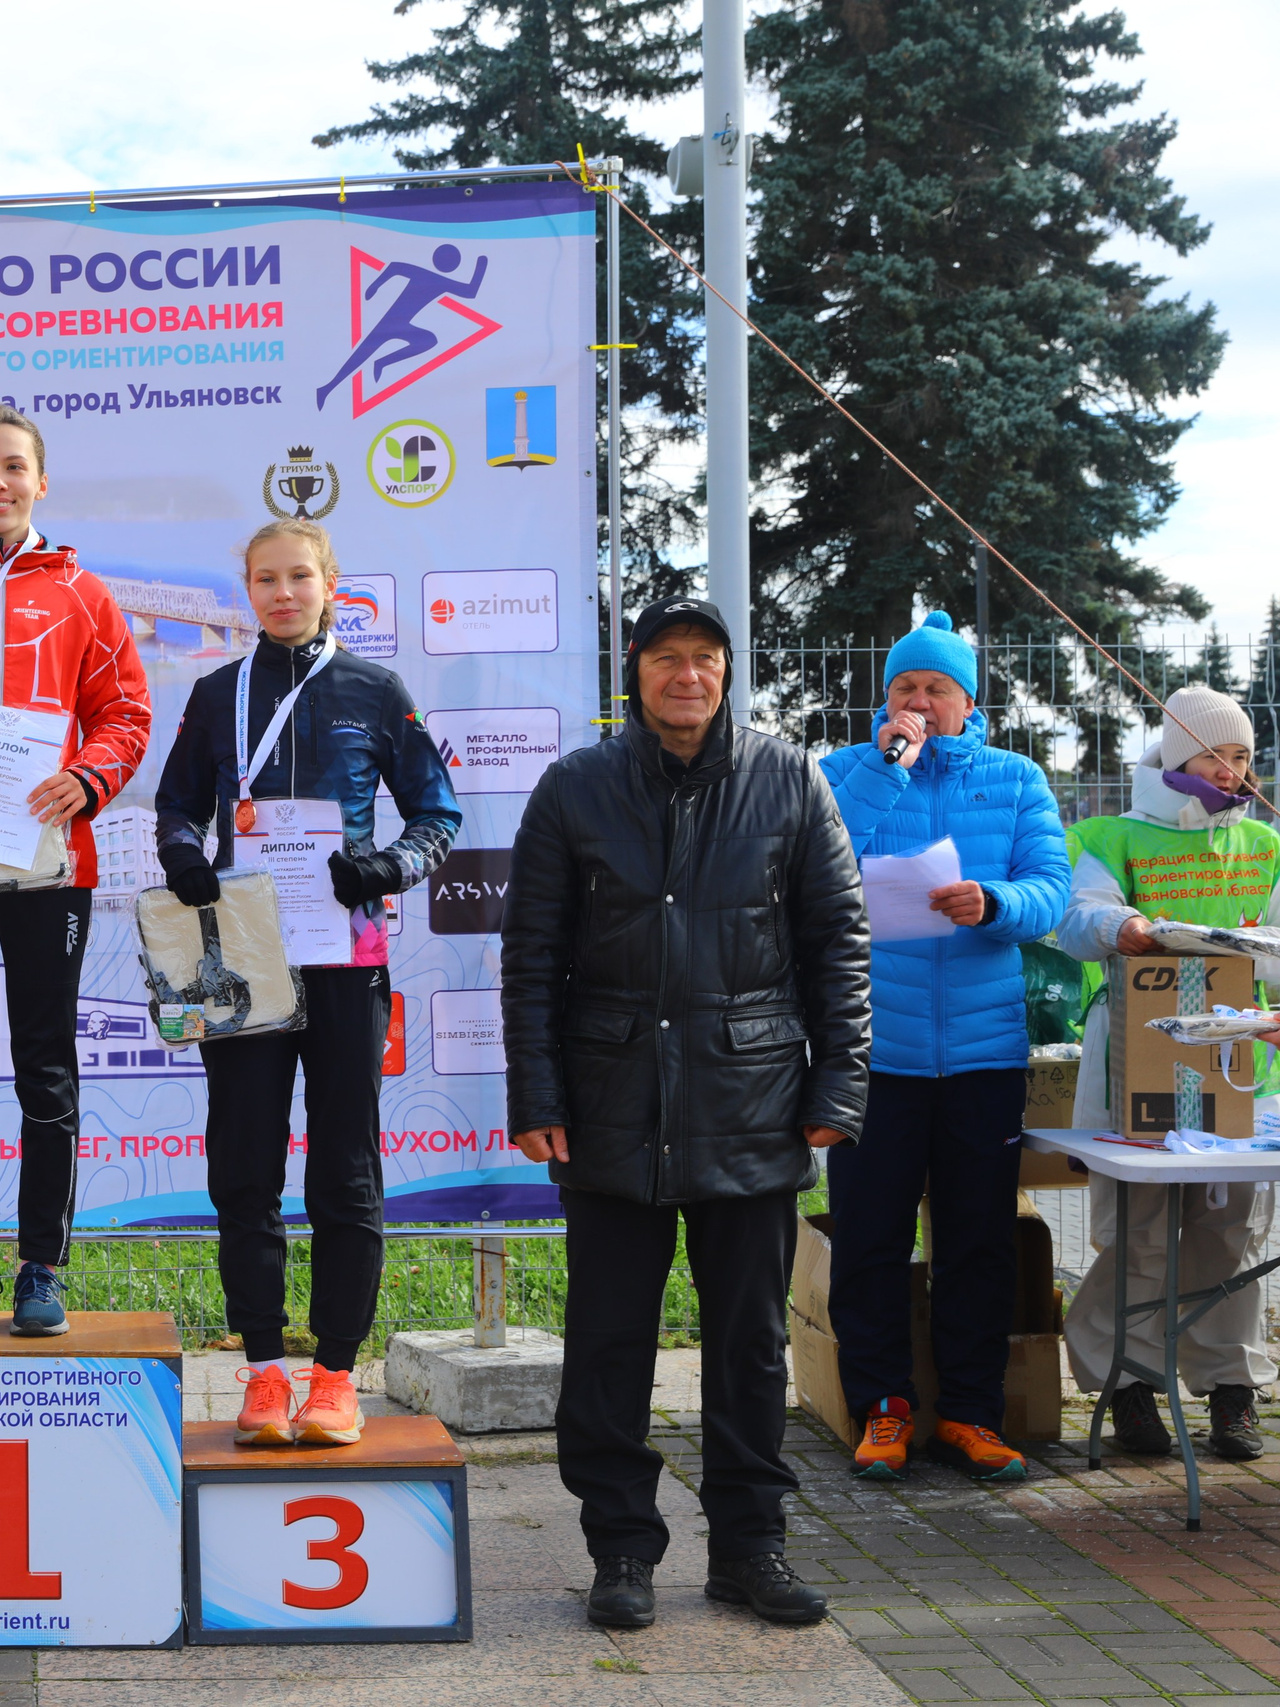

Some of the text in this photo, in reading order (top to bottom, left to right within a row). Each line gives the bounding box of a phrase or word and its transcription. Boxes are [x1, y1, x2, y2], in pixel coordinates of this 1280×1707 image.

[50, 245, 282, 294] РОССИИ
[32, 340, 285, 372] ОРИЕНТИРОВАНИЯ
[33, 392, 120, 419] город
[127, 383, 282, 410] Ульяновск
[279, 464, 322, 474] ТРИУМФ
[385, 484, 437, 495] УЛСПОРТ
[462, 594, 551, 616] azimut
[462, 622, 491, 630] ОТЕЛЬ
[467, 734, 527, 743] МЕТАЛЛО
[467, 743, 557, 755] ПРОФИЛЬНЫЙ
[467, 758, 509, 767] ЗАВОД
[261, 842, 315, 854] ДИПЛОМ
[1141, 1102, 1155, 1123] L
[76, 1136, 111, 1162] ЕГ,
[1, 1370, 142, 1386] СПОРТИВНОГО
[39, 1412, 128, 1427] ОБЛАСТИ
[281, 1495, 369, 1610] 3
